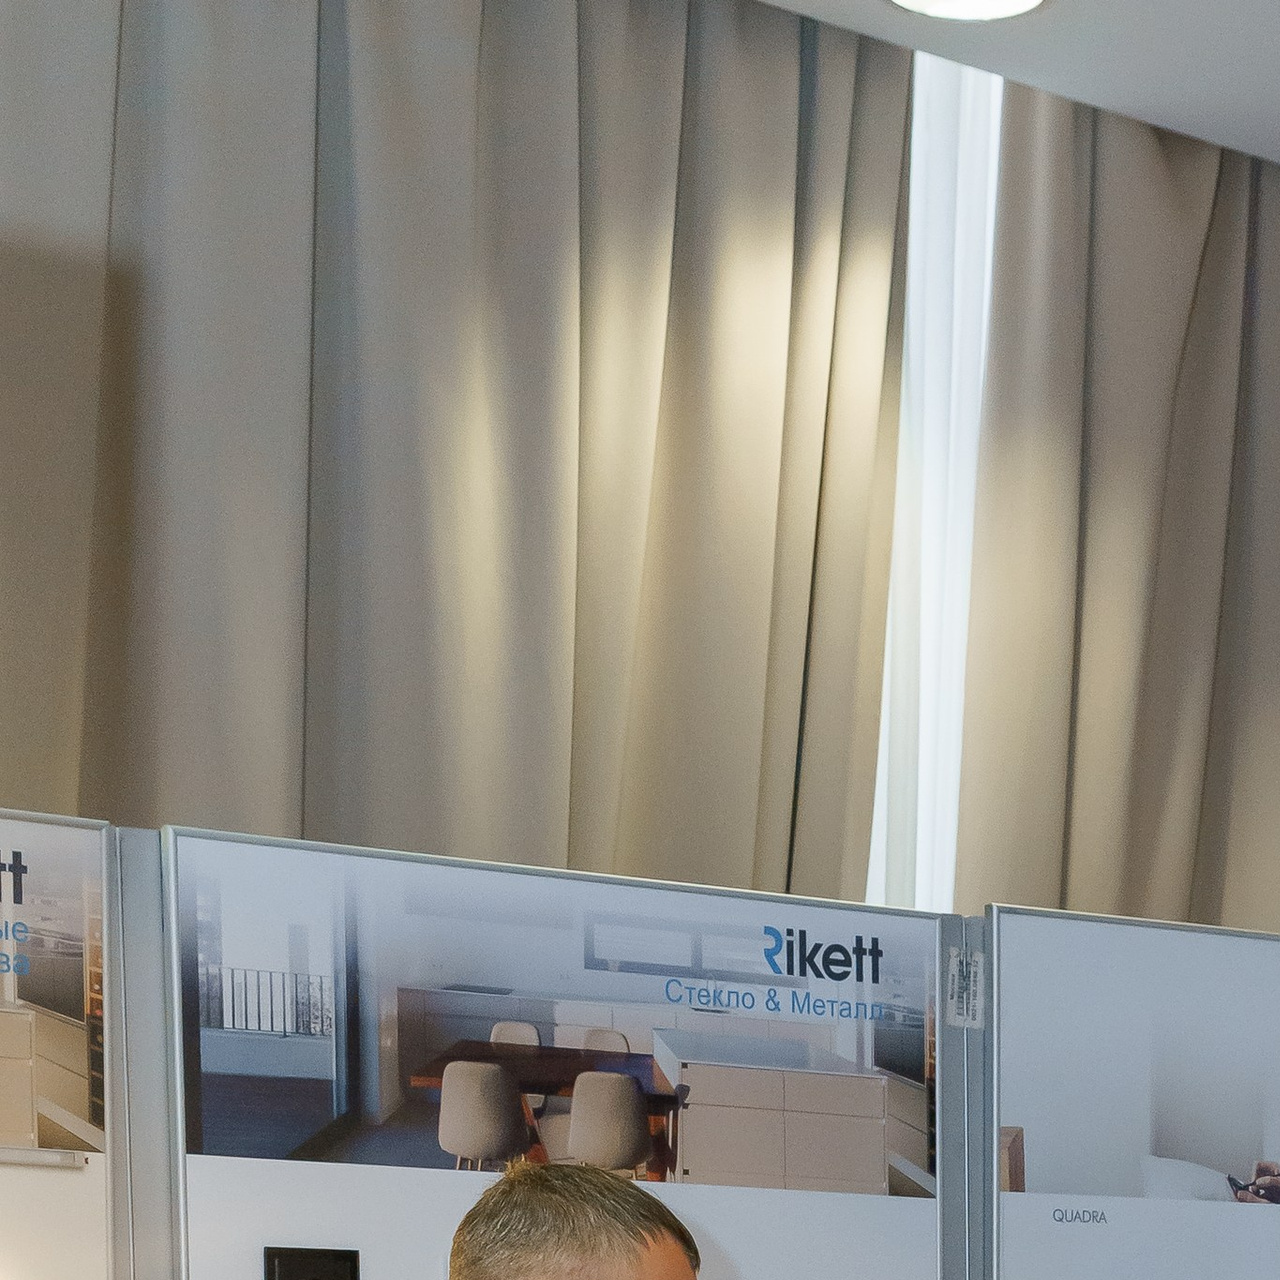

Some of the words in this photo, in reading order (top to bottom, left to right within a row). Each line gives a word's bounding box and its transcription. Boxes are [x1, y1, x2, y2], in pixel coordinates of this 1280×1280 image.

[763, 925, 884, 984] Rikett
[664, 978, 756, 1010] Стекло
[764, 988, 781, 1012] &
[790, 991, 884, 1020] Металл
[1052, 1208, 1108, 1225] QUADRA
